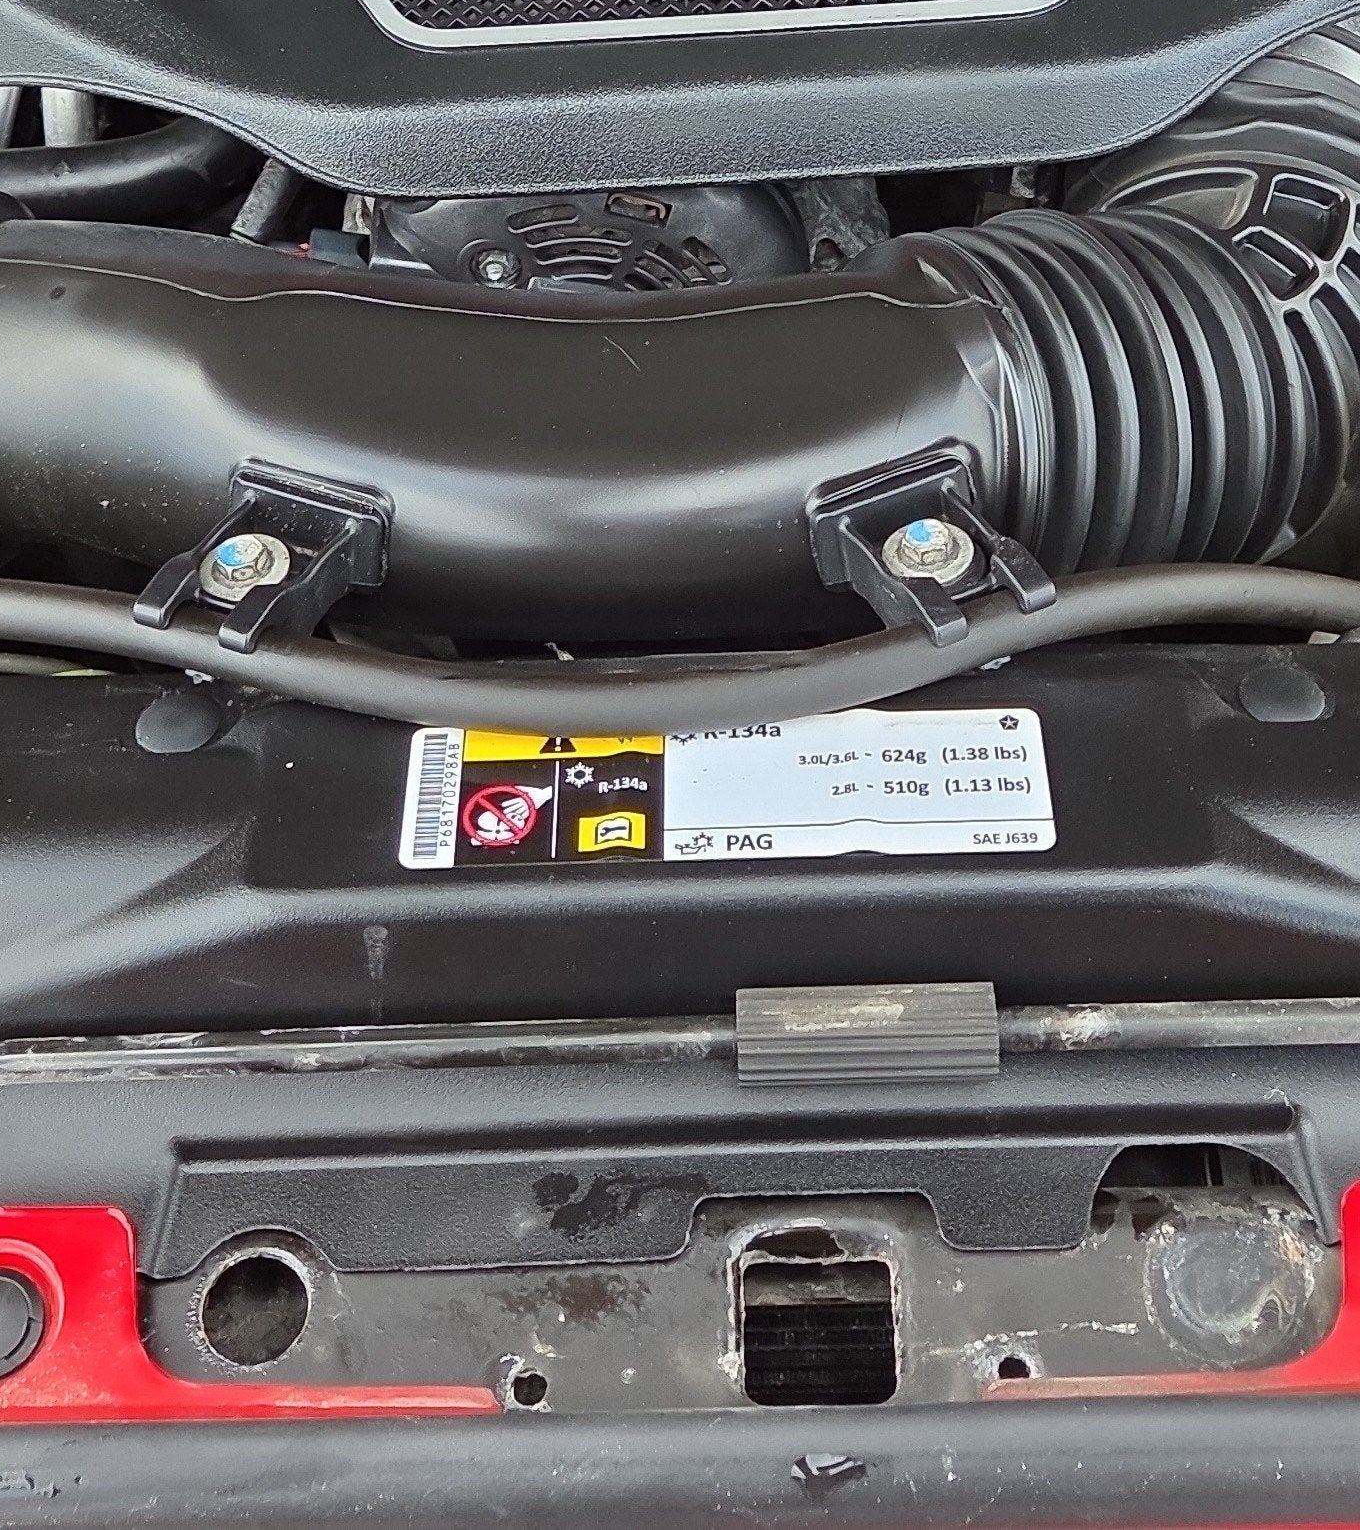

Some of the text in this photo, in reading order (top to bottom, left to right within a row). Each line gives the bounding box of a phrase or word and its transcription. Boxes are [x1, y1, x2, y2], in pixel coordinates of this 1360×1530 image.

[797, 750, 859, 767] 3.0L/3.6L
[881, 746, 927, 767] 624g
[942, 745, 987, 766] (1.38
[991, 743, 1028, 765] lbs)
[437, 740, 462, 848] P68170298AB
[598, 777, 648, 795] R-134a
[831, 783, 860, 797] 2.8L
[883, 777, 929, 799] 510g
[944, 776, 991, 797] (1.13
[994, 774, 1032, 795] lbs)
[726, 832, 774, 853] PAG
[972, 831, 1038, 847] SAE J639
